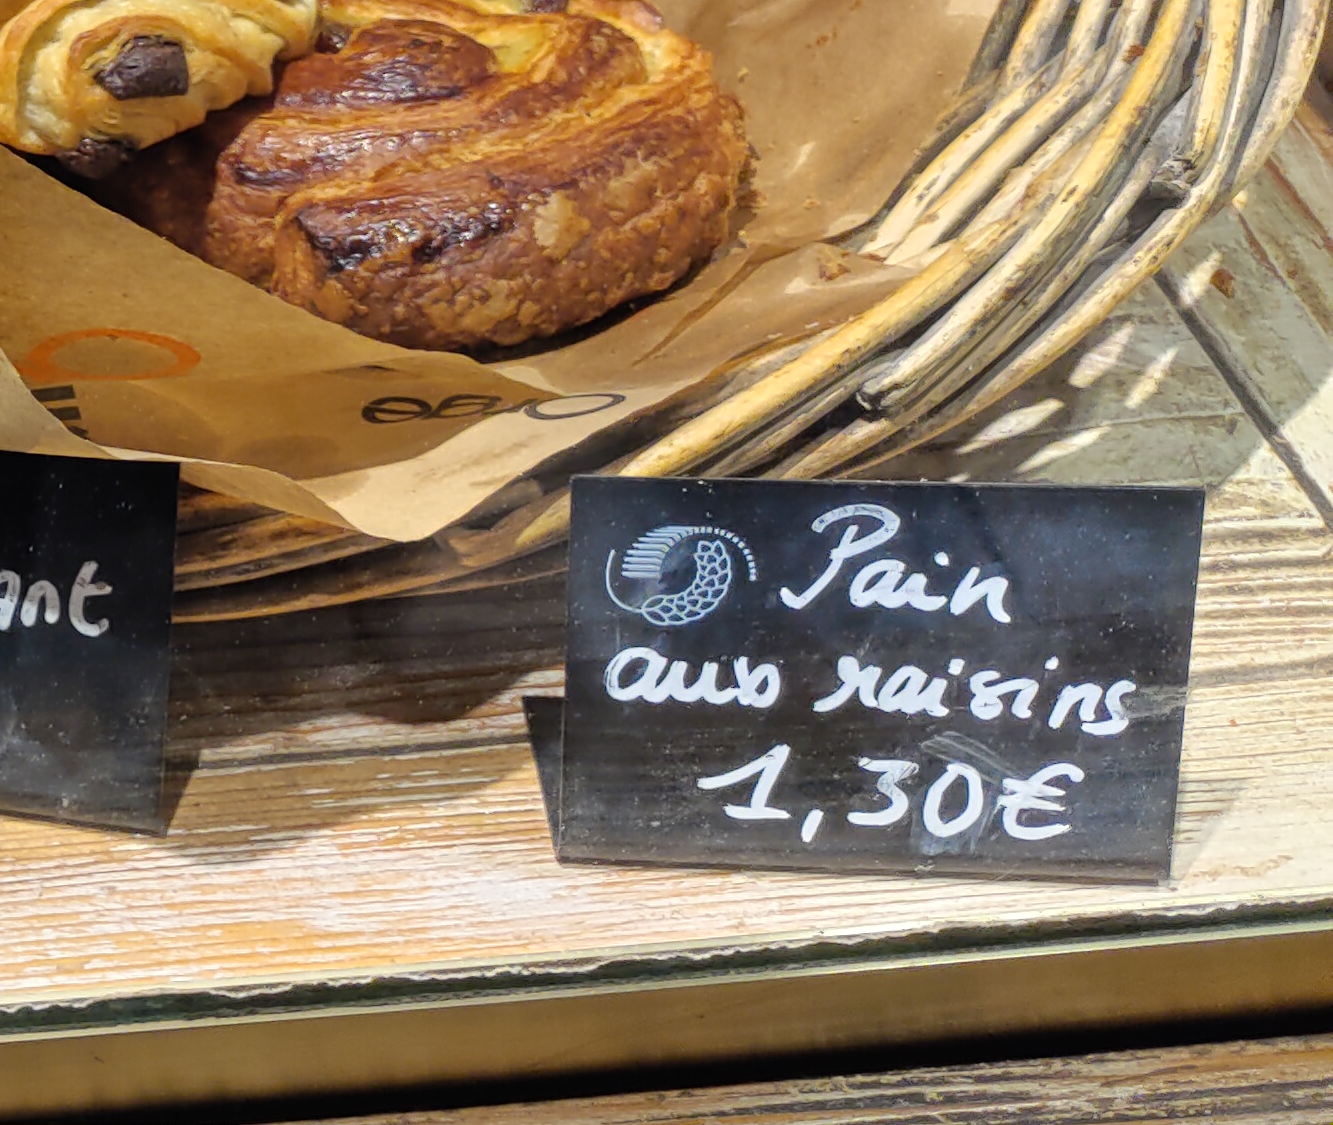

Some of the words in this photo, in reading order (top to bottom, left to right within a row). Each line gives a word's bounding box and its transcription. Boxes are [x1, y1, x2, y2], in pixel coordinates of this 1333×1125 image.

[779, 502, 1012, 624] Pain
[603, 646, 782, 709] aux
[812, 655, 1137, 736] raisins
[695, 743, 1086, 844] 1,30€
